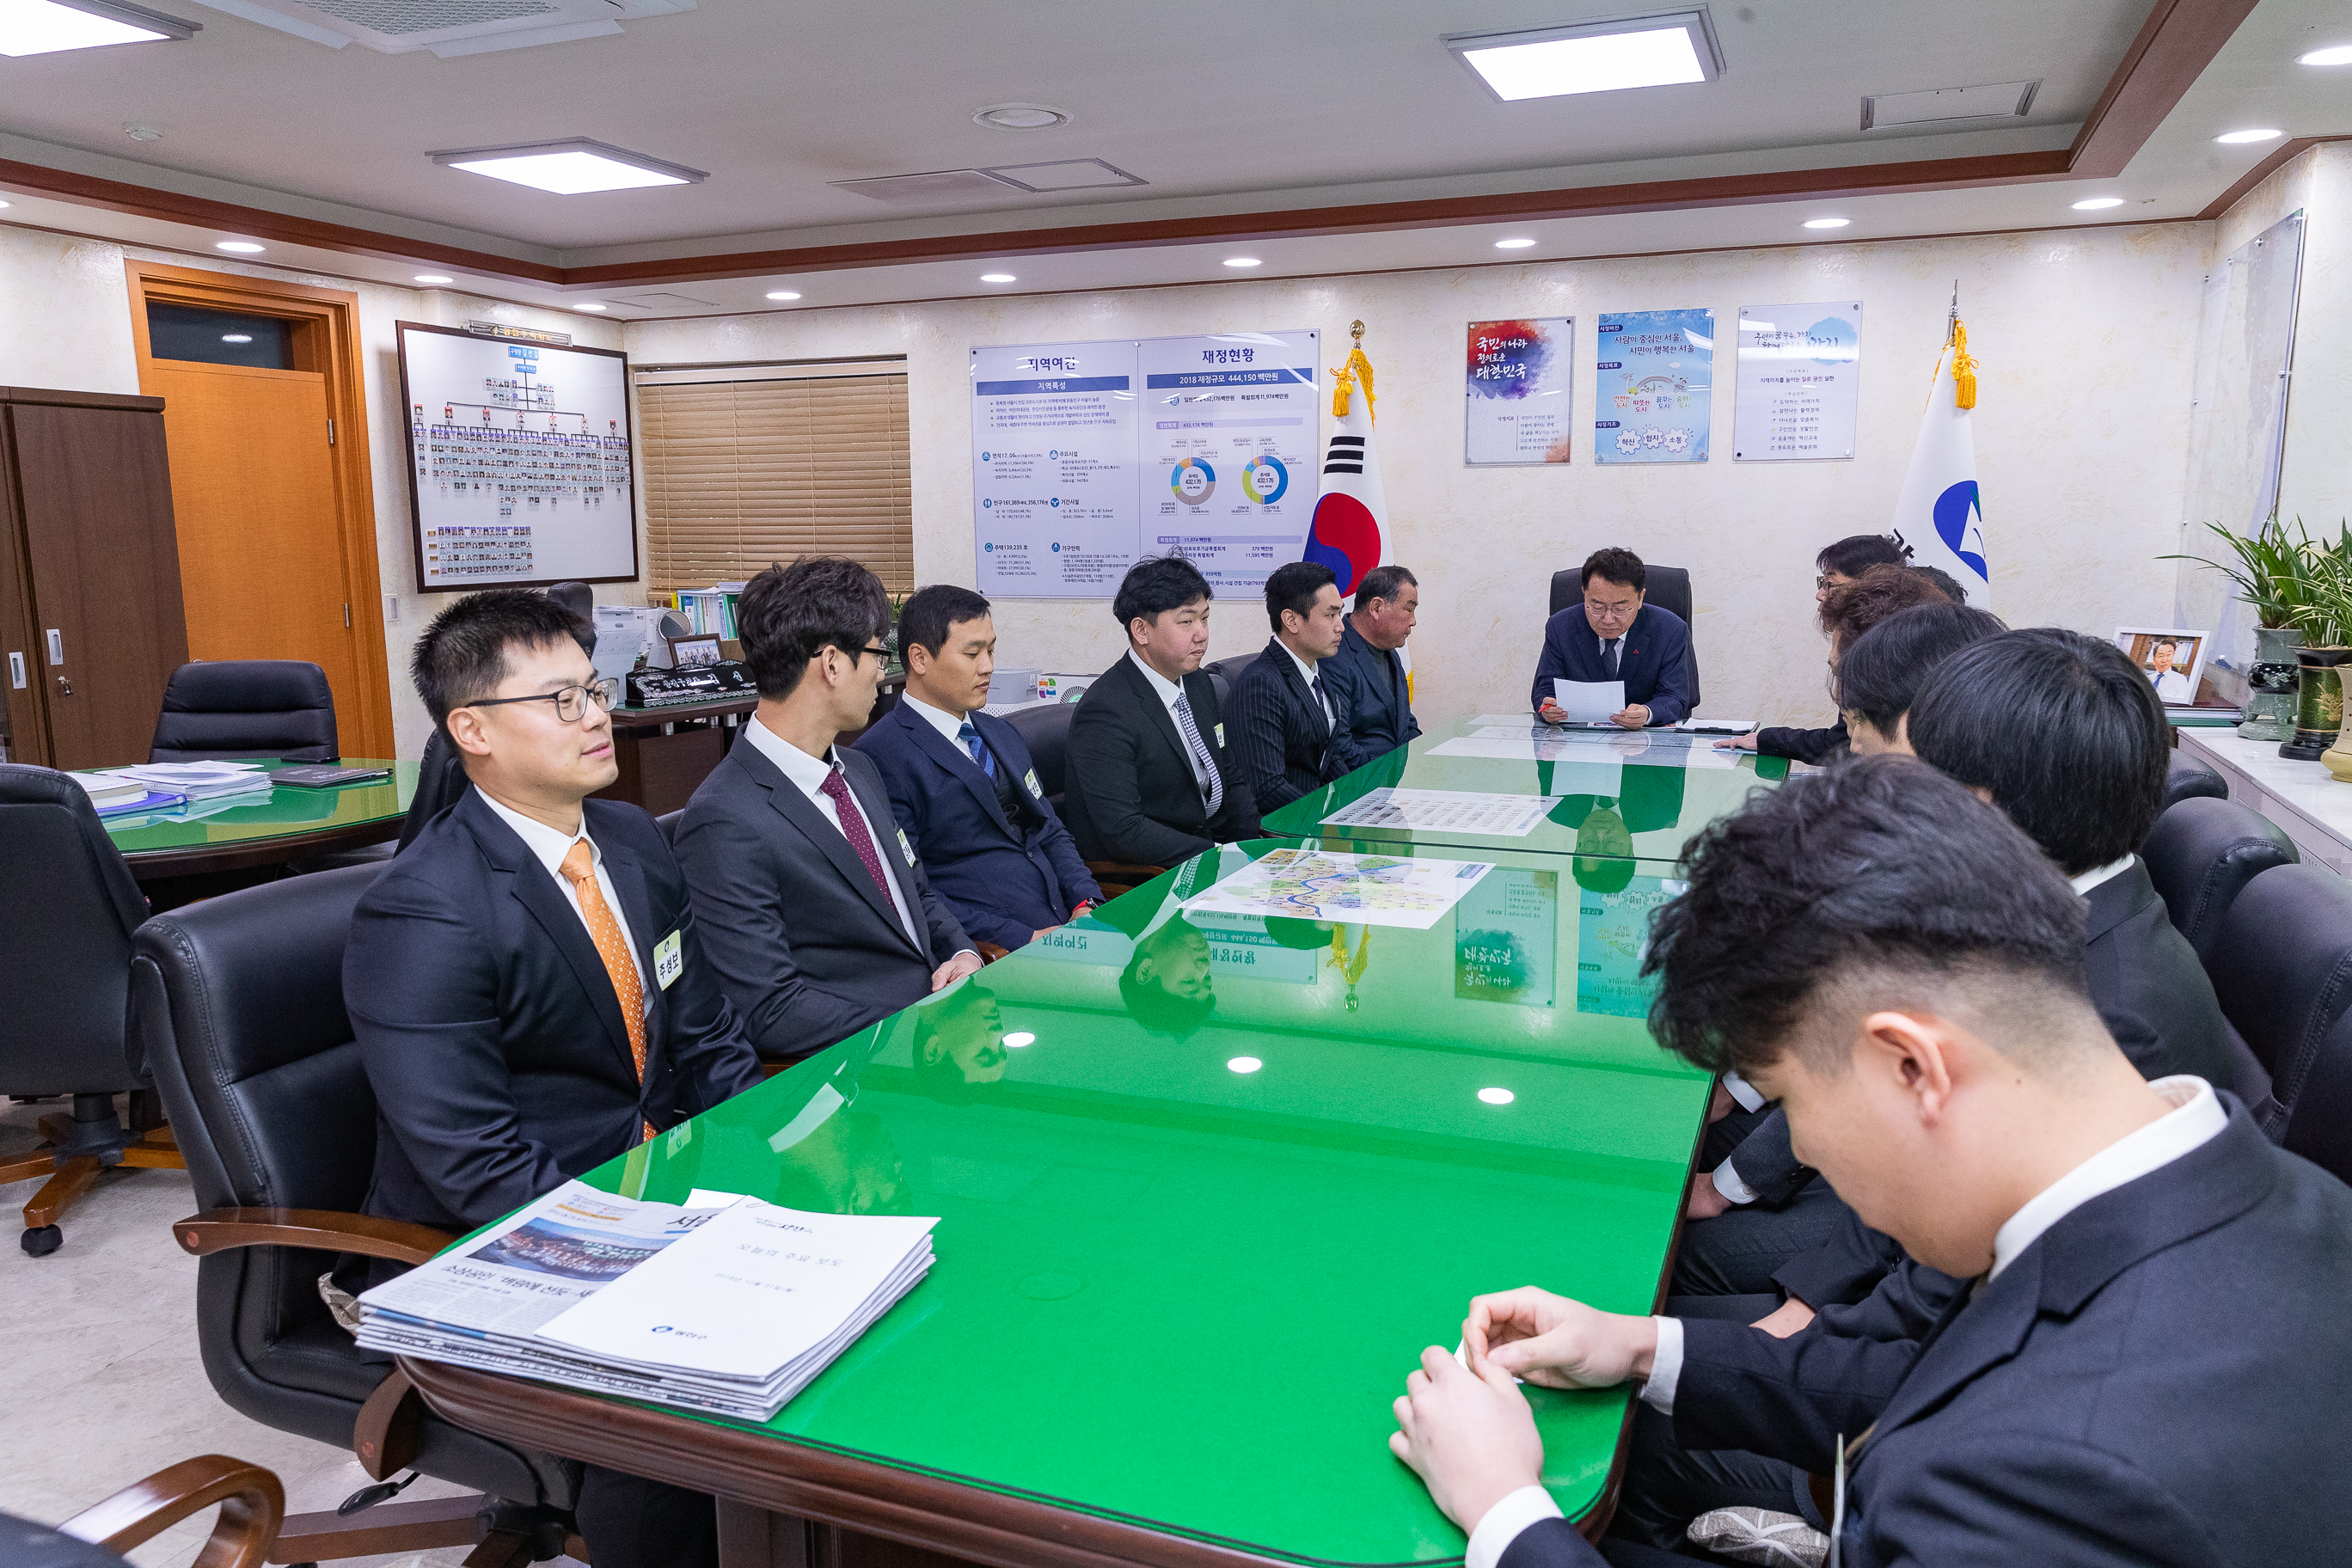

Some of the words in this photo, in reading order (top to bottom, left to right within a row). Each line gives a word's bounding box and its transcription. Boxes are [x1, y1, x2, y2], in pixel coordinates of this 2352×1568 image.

[1477, 337, 1506, 352] 국민의
[1509, 339, 1528, 349] 나라
[1630, 346, 1651, 355] 시민이
[1203, 348, 1254, 364] 재정현황
[1478, 352, 1505, 364] 정의로운
[1476, 363, 1527, 380] 대한민국
[1179, 376, 1197, 384] 2018
[1198, 375, 1225, 383] 재정규모
[1228, 373, 1256, 383] 444,150
[1258, 372, 1278, 382] 백만원
[1038, 382, 1066, 390] 지역특성
[784, 1253, 810, 1262] 주요
